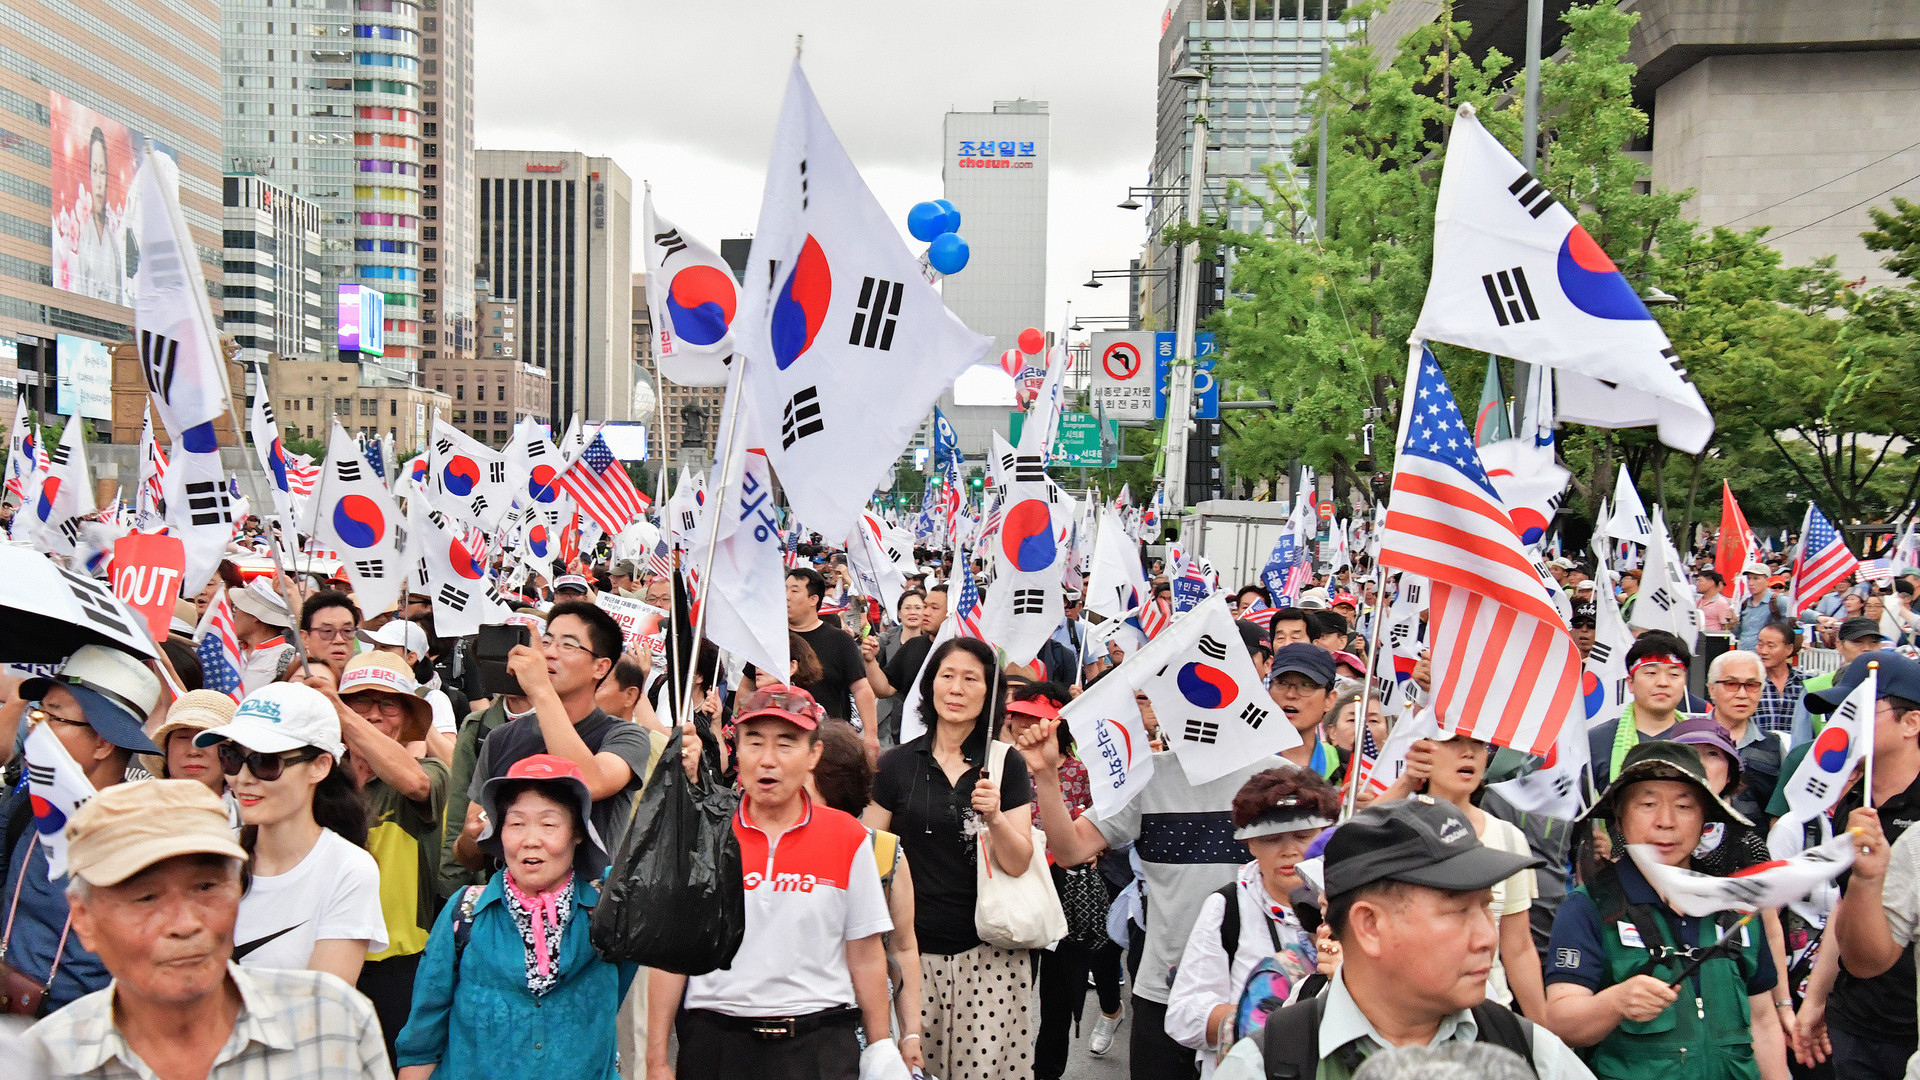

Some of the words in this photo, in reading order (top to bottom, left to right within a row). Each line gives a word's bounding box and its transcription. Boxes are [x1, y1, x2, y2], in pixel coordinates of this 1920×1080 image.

[957, 141, 1037, 157] 조선일보
[958, 157, 1034, 168] chosun.com
[371, 668, 396, 683] 퇴진
